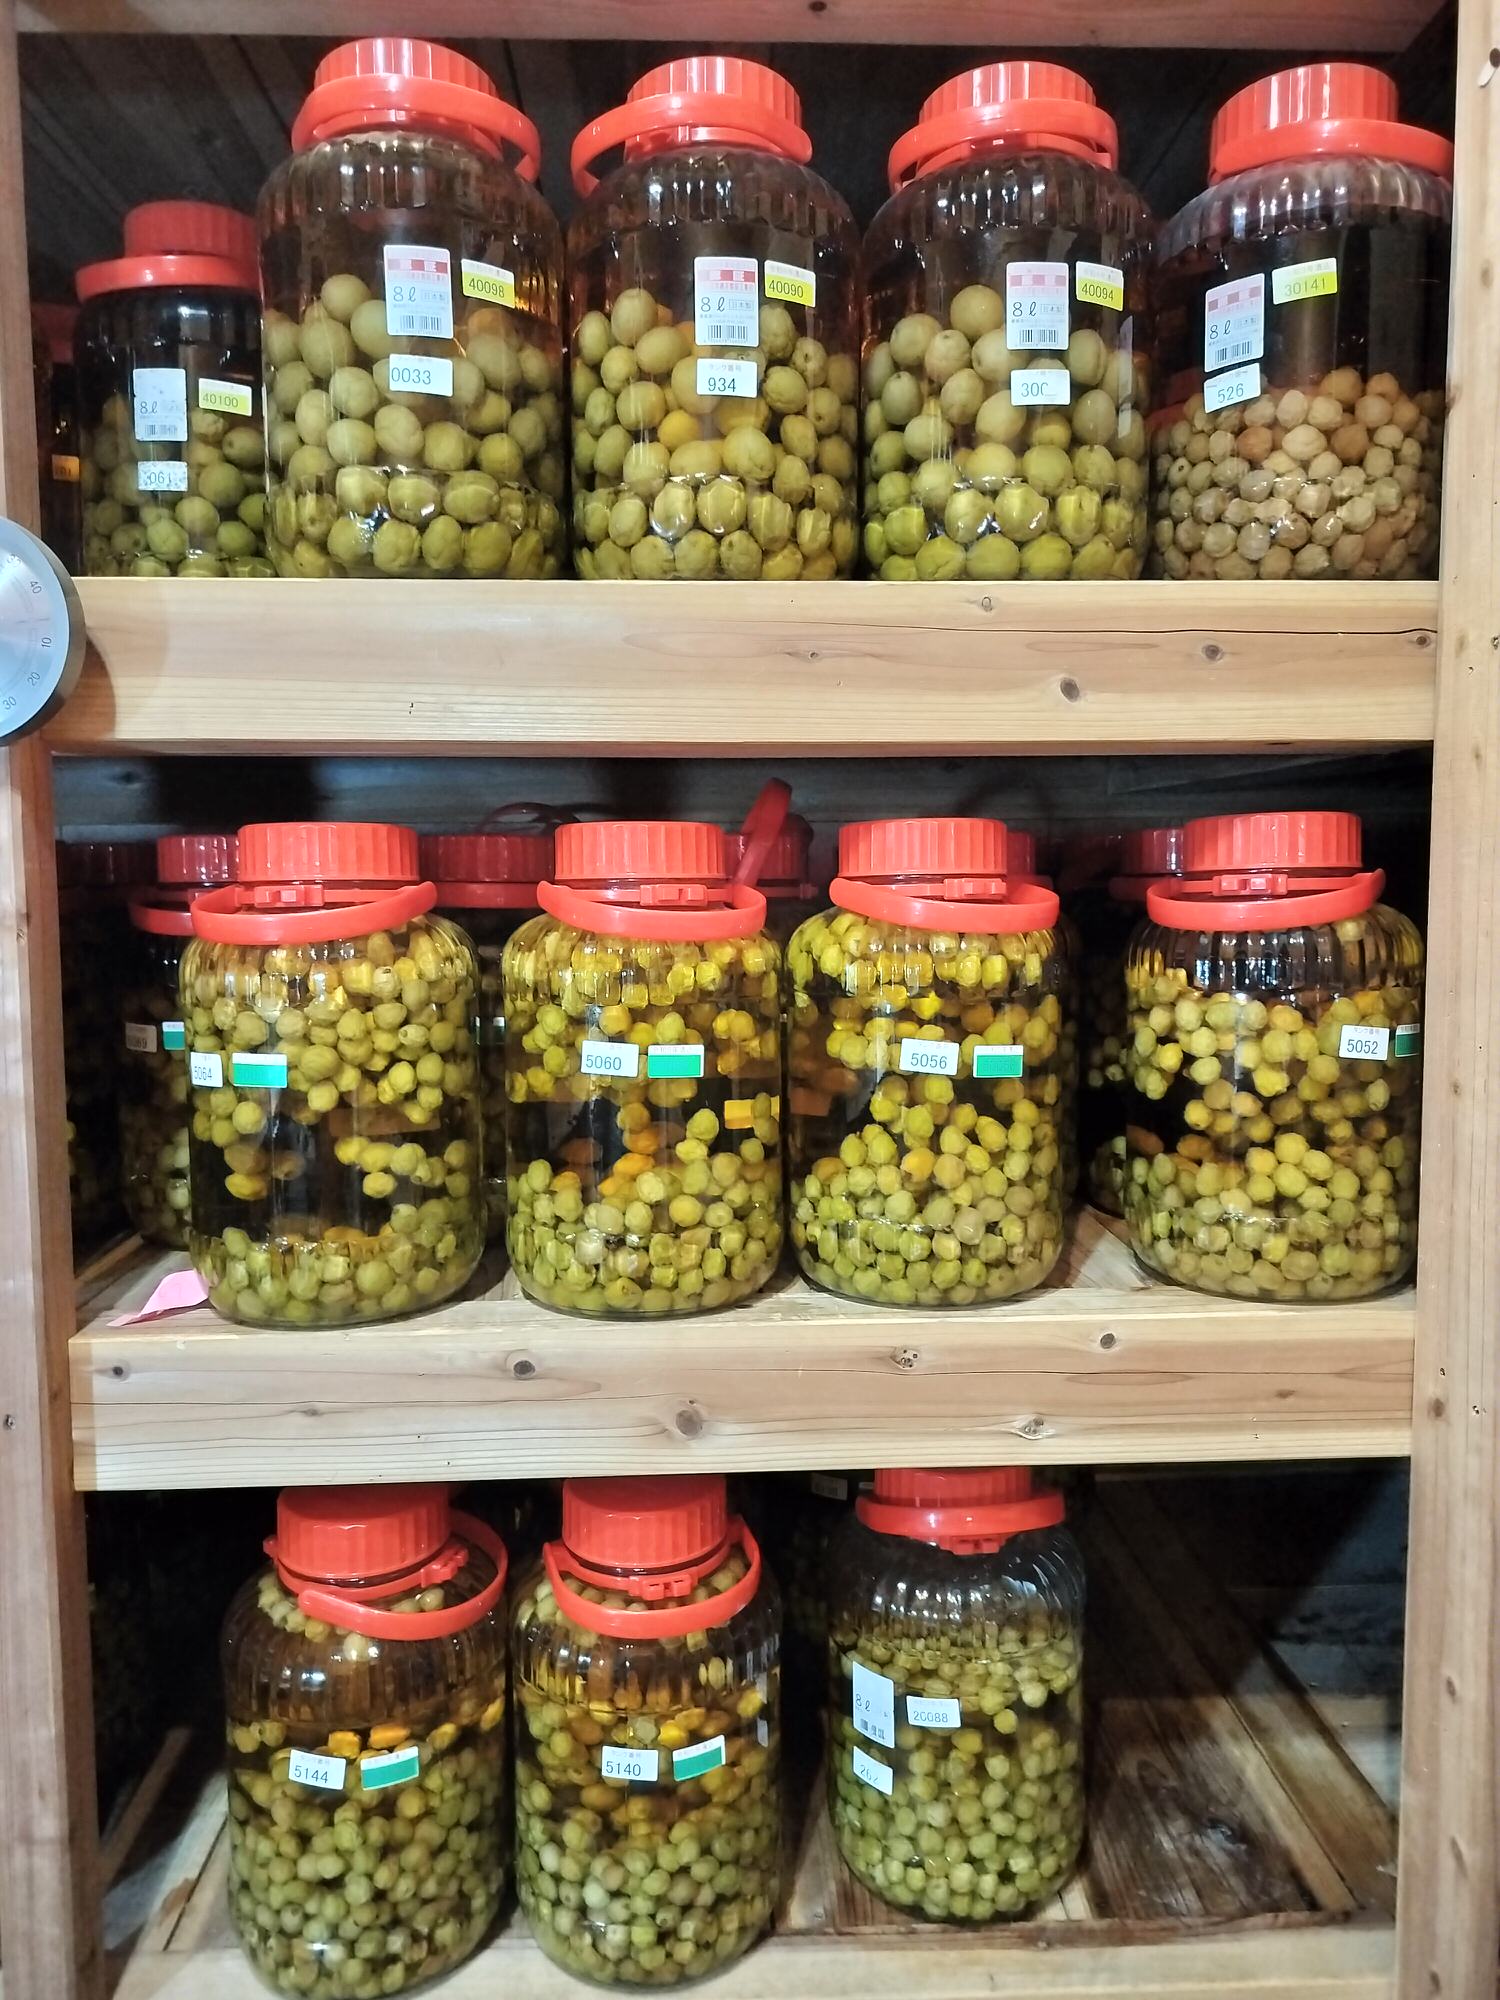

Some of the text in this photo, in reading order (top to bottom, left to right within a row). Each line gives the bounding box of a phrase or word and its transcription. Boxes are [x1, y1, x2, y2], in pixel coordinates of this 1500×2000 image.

[468, 278, 505, 298] 40098
[768, 279, 804, 298] 40090
[1081, 282, 1114, 302] 40094
[1284, 277, 1326, 297] 30141
[391, 367, 431, 385] 0033
[708, 377, 737, 393] 934
[202, 393, 239, 409] 40100
[1217, 383, 1244, 404] 526
[29, 580, 42, 594] 40
[41, 637, 52, 648] 10
[27, 671, 40, 687] 20
[2, 696, 17, 711] 30
[1347, 1039, 1378, 1054] 5052
[586, 1055, 622, 1071] 5060
[910, 1053, 948, 1069] 5056
[294, 1765, 329, 1783] 5144
[605, 1761, 641, 1777] 5140
